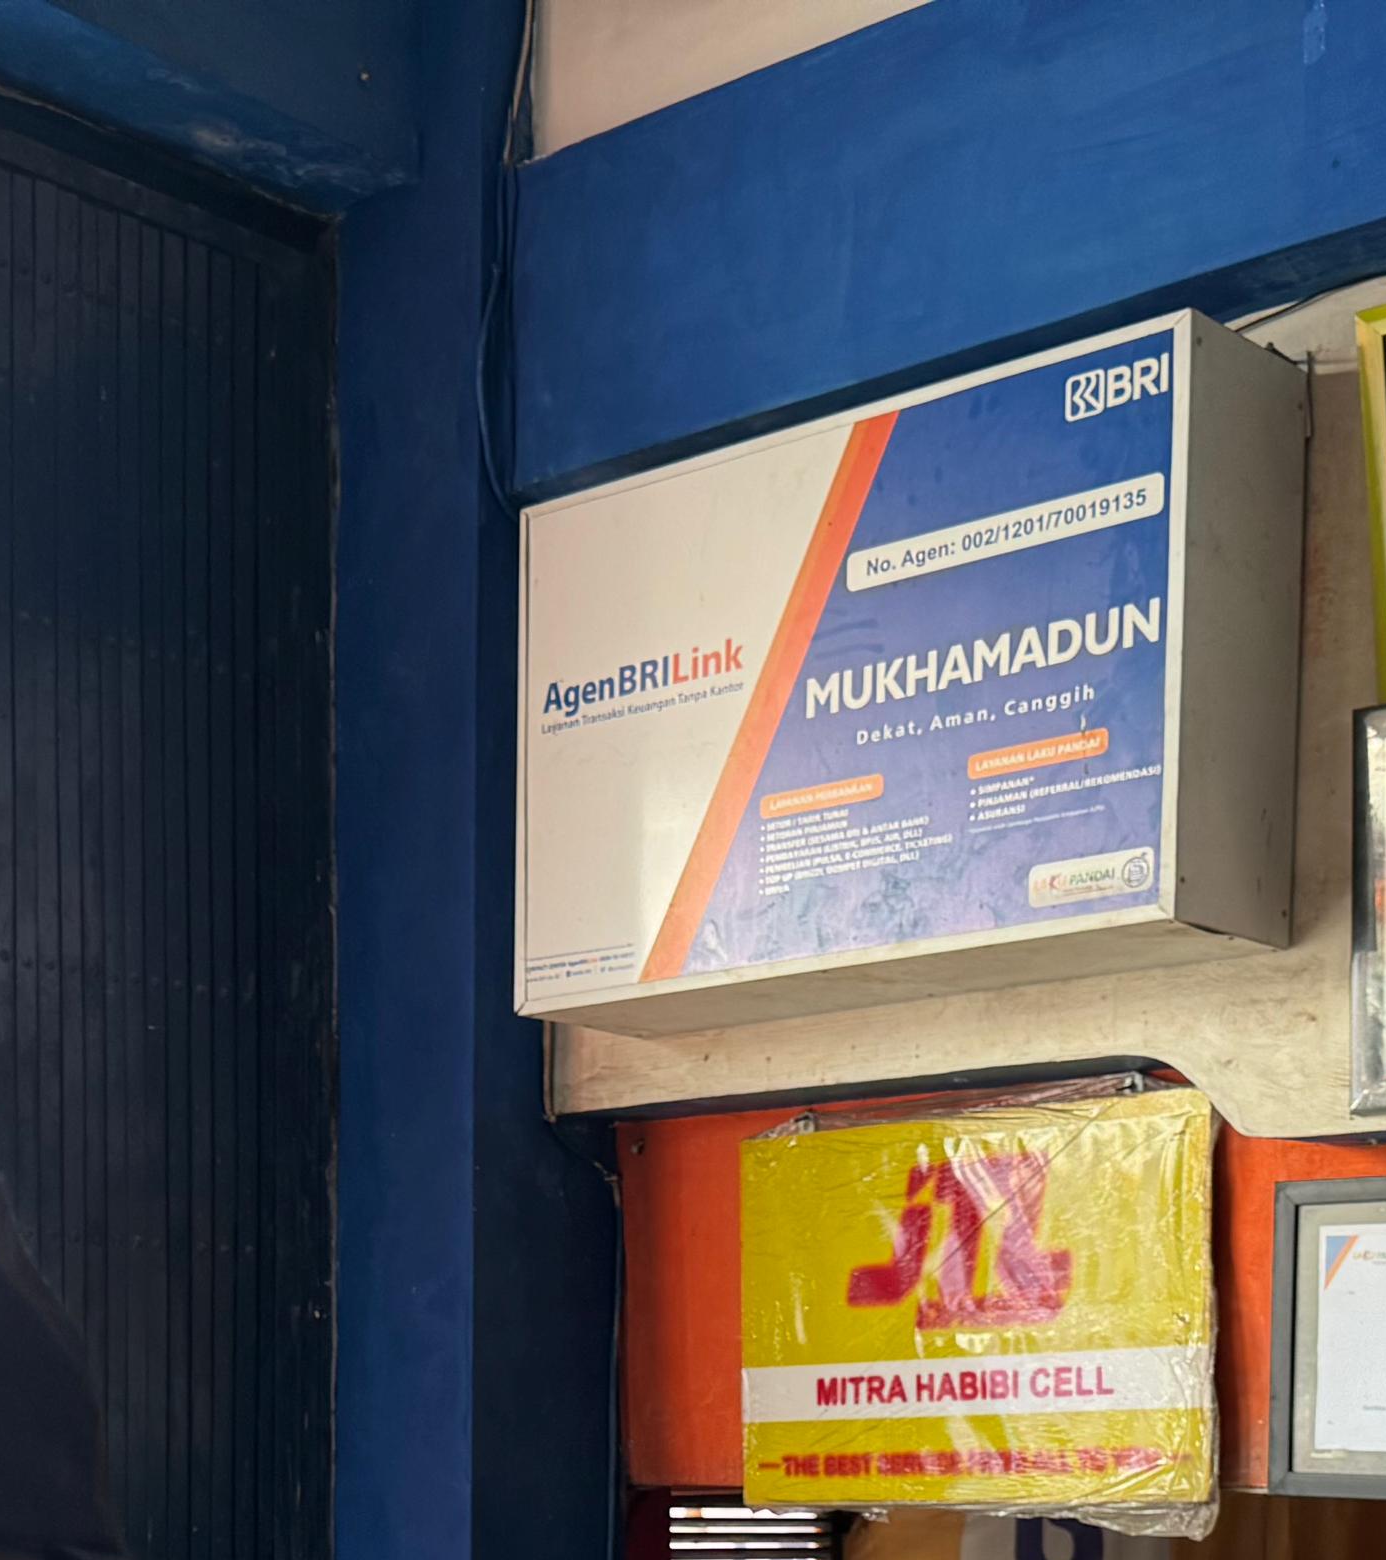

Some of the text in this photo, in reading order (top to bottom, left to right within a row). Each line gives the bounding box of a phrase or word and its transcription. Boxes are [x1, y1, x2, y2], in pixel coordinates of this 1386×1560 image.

[1106, 352, 1169, 408] BRI
[867, 489, 1147, 576] No. Agen: 002/1201/70019135
[542, 638, 743, 716] AgenBRILink
[805, 598, 1161, 719] MUKHAMADUN
[856, 684, 1095, 745] Dekat, Aman, Canggih
[816, 1365, 1114, 1407] MITRA HABIBI CELL
